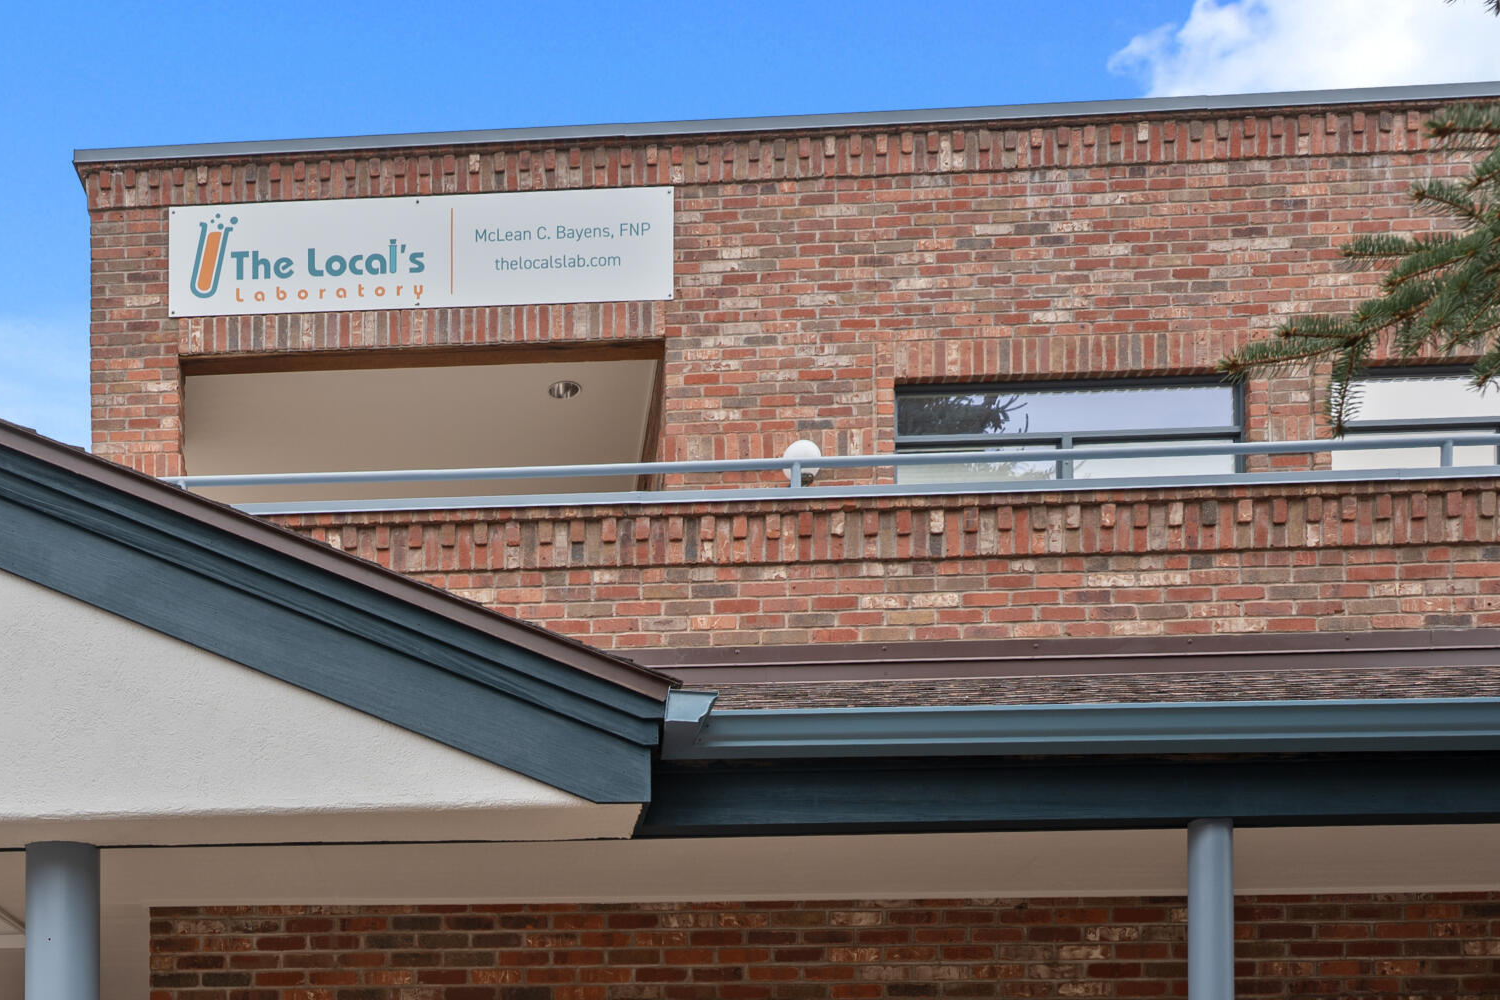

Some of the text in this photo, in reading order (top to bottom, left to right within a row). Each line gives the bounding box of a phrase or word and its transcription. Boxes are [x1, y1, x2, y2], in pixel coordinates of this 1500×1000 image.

[475, 222, 651, 243] McLean C. Bayens, FNP
[231, 238, 426, 281] The Local's
[494, 254, 621, 271] thelocalslab.com
[235, 284, 425, 303] Laboratory
